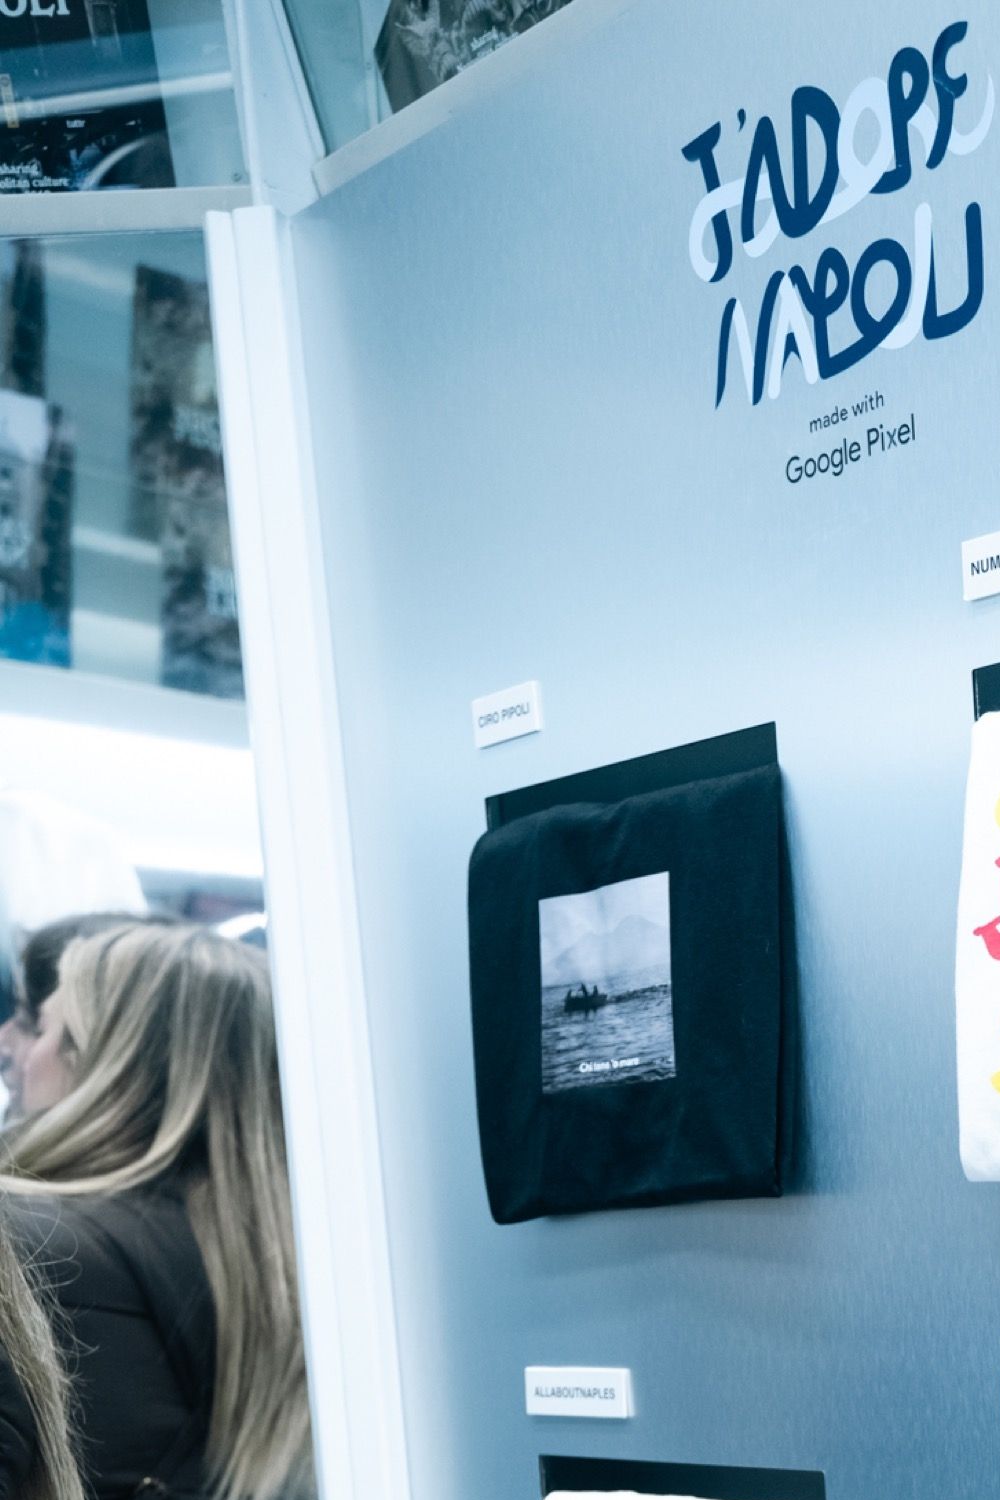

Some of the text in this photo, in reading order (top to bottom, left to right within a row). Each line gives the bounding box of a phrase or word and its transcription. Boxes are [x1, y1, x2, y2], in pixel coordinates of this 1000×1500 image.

[809, 390, 885, 433] made with
[786, 412, 916, 483] Google Pixel
[534, 1386, 616, 1400] ALLABOUTNAPLES
